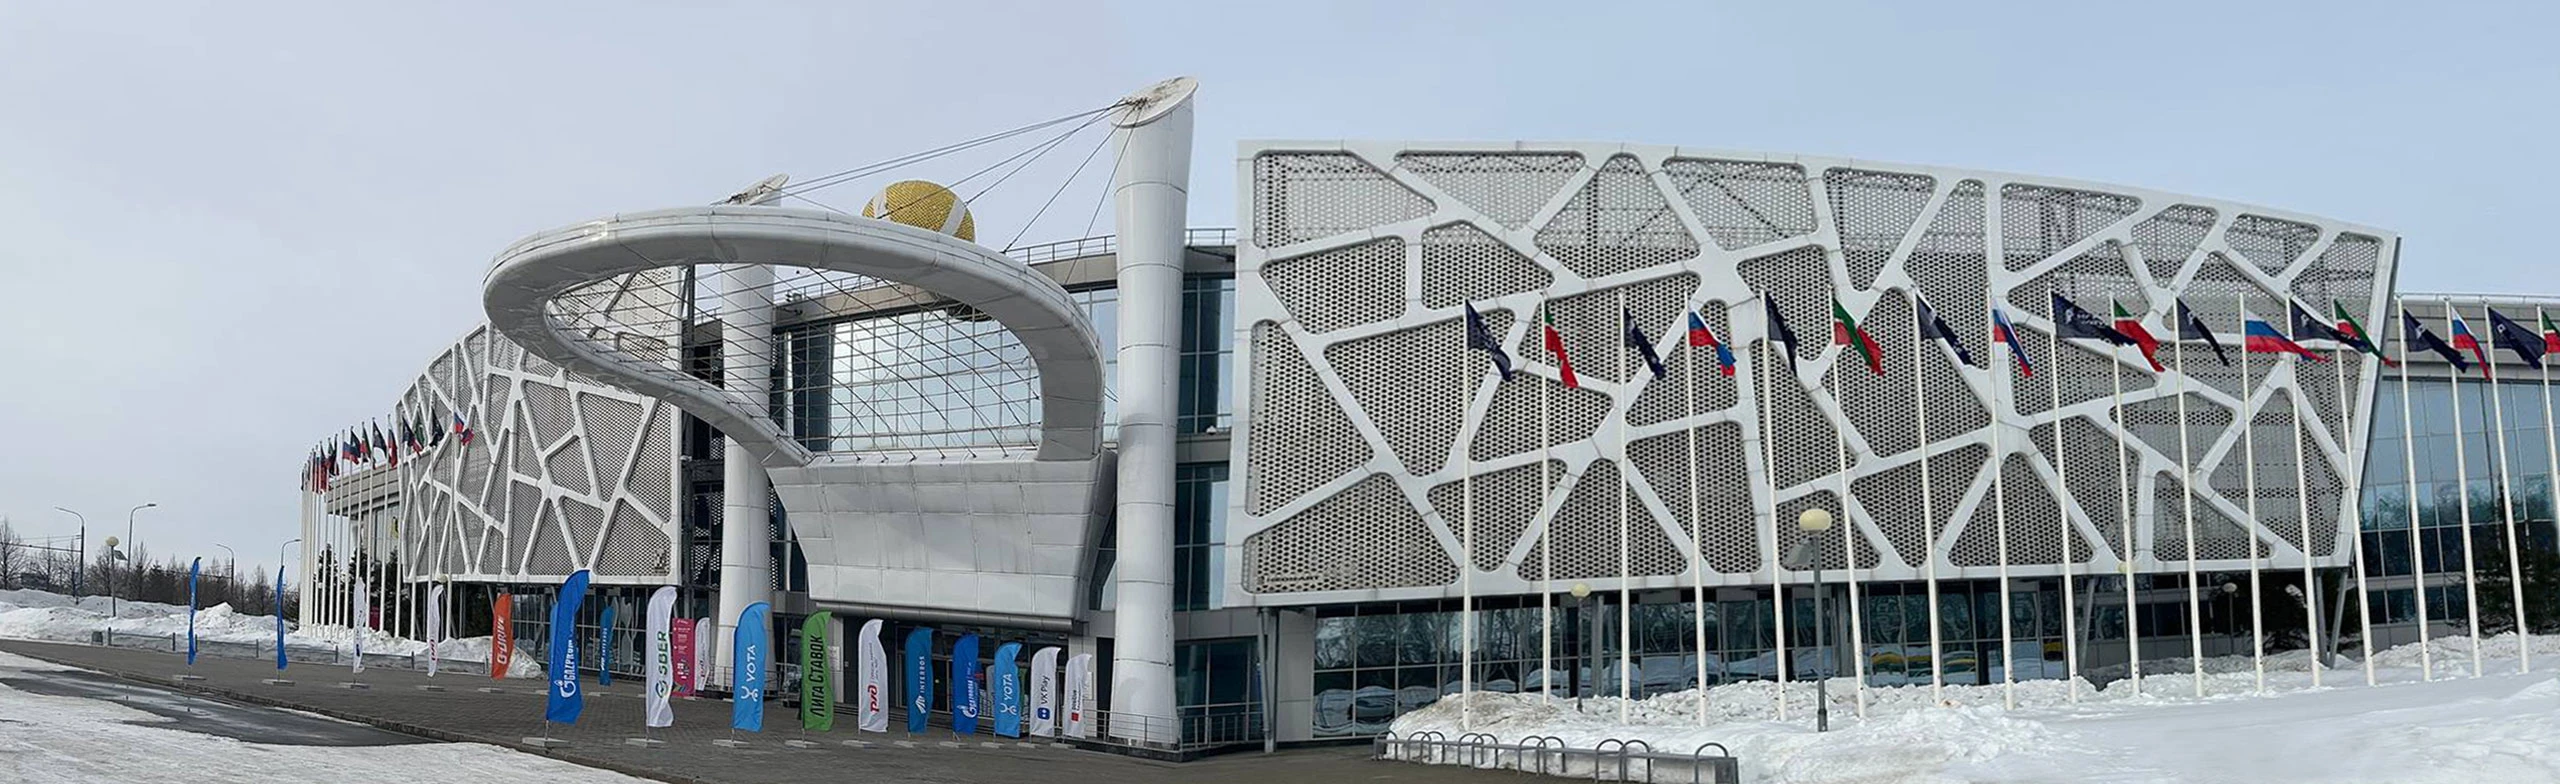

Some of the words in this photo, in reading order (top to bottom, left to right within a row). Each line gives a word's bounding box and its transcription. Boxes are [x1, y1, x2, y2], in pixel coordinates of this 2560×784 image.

[496, 615, 508, 665] G-DRIVE
[562, 639, 576, 681] GAZPROM
[656, 630, 668, 676] SBER
[746, 644, 756, 682] YOTA
[918, 655, 926, 694] INTERROS
[1002, 673, 1013, 701] YOTA
